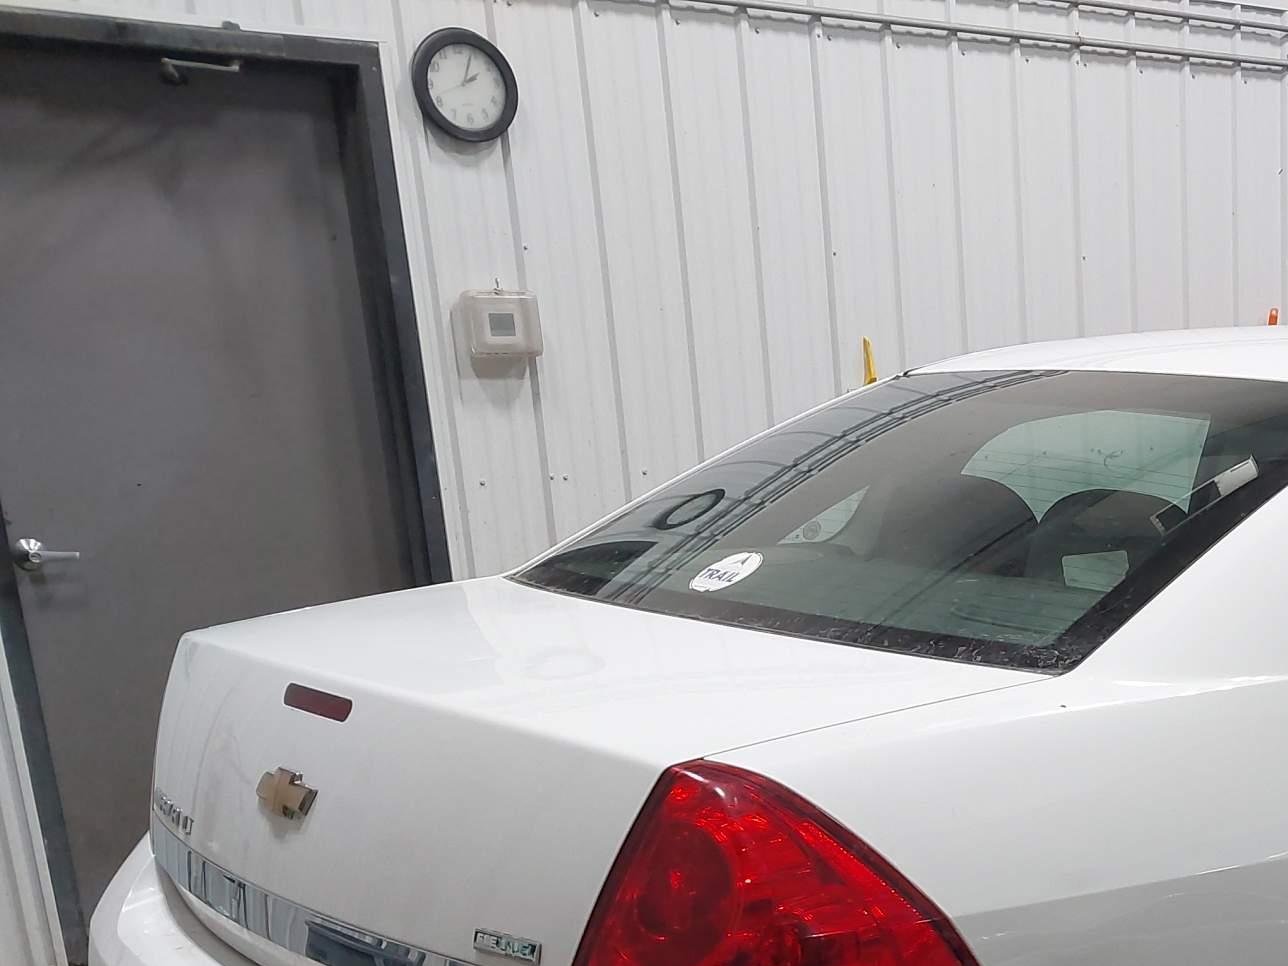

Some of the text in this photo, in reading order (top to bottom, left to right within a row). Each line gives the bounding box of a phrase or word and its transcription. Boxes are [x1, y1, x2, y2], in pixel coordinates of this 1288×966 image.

[436, 95, 443, 107] 8
[450, 108, 457, 121] 7
[467, 112, 474, 124] 6
[699, 568, 739, 582] TRAIL
